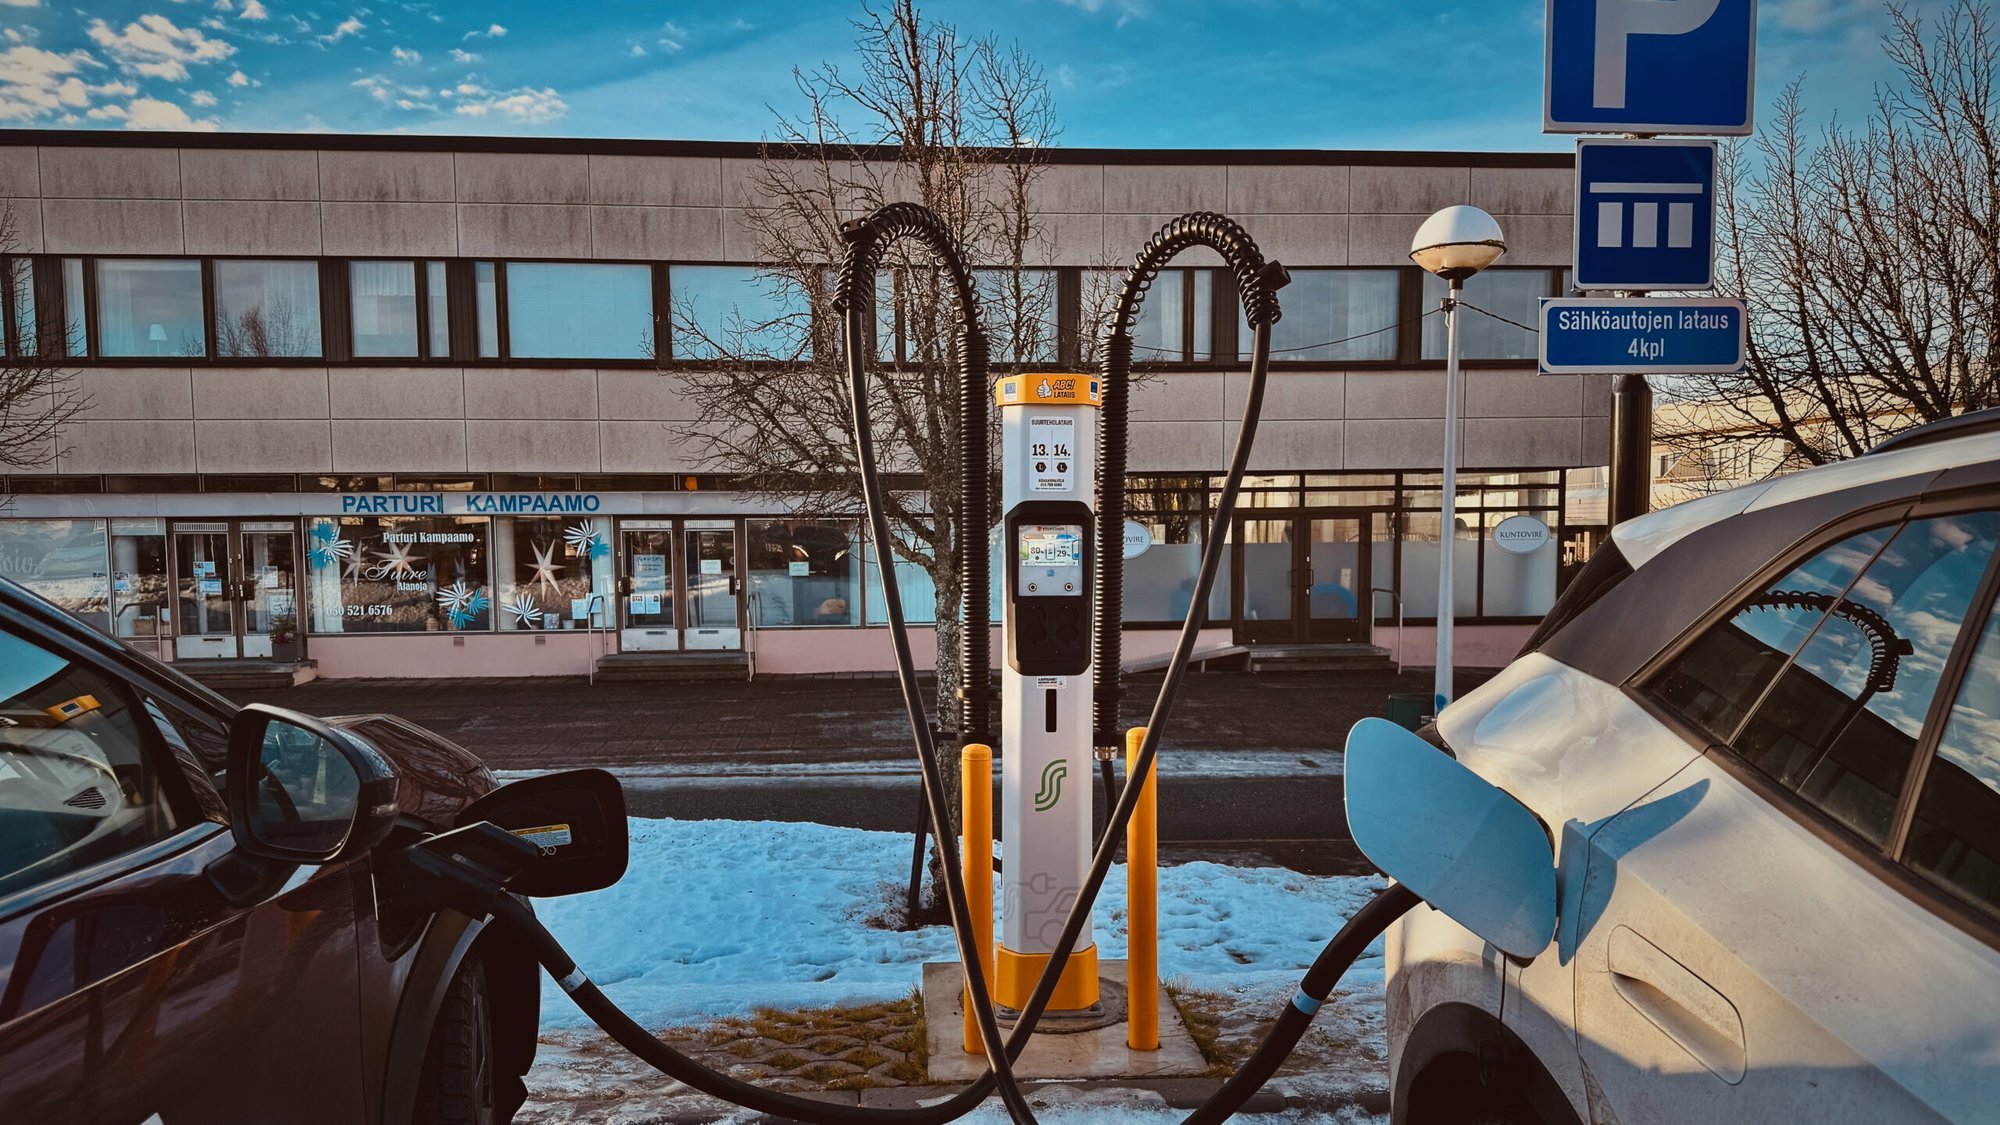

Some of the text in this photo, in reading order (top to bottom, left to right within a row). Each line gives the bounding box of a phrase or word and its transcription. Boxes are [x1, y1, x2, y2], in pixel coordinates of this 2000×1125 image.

[1593, 0, 1721, 108] P
[1558, 310, 1729, 333] Sähköautojen lataus
[1627, 337, 1664, 360] 4kpl
[1053, 379, 1076, 390] ABC!
[1032, 443, 1071, 457] 13. 14.
[342, 495, 600, 513] PARTURI KAMPAAMO
[383, 532, 474, 544] Parturi Kampaamo
[1500, 530, 1542, 538] KUNTOVIRE
[326, 604, 393, 616] 050 521 6576
